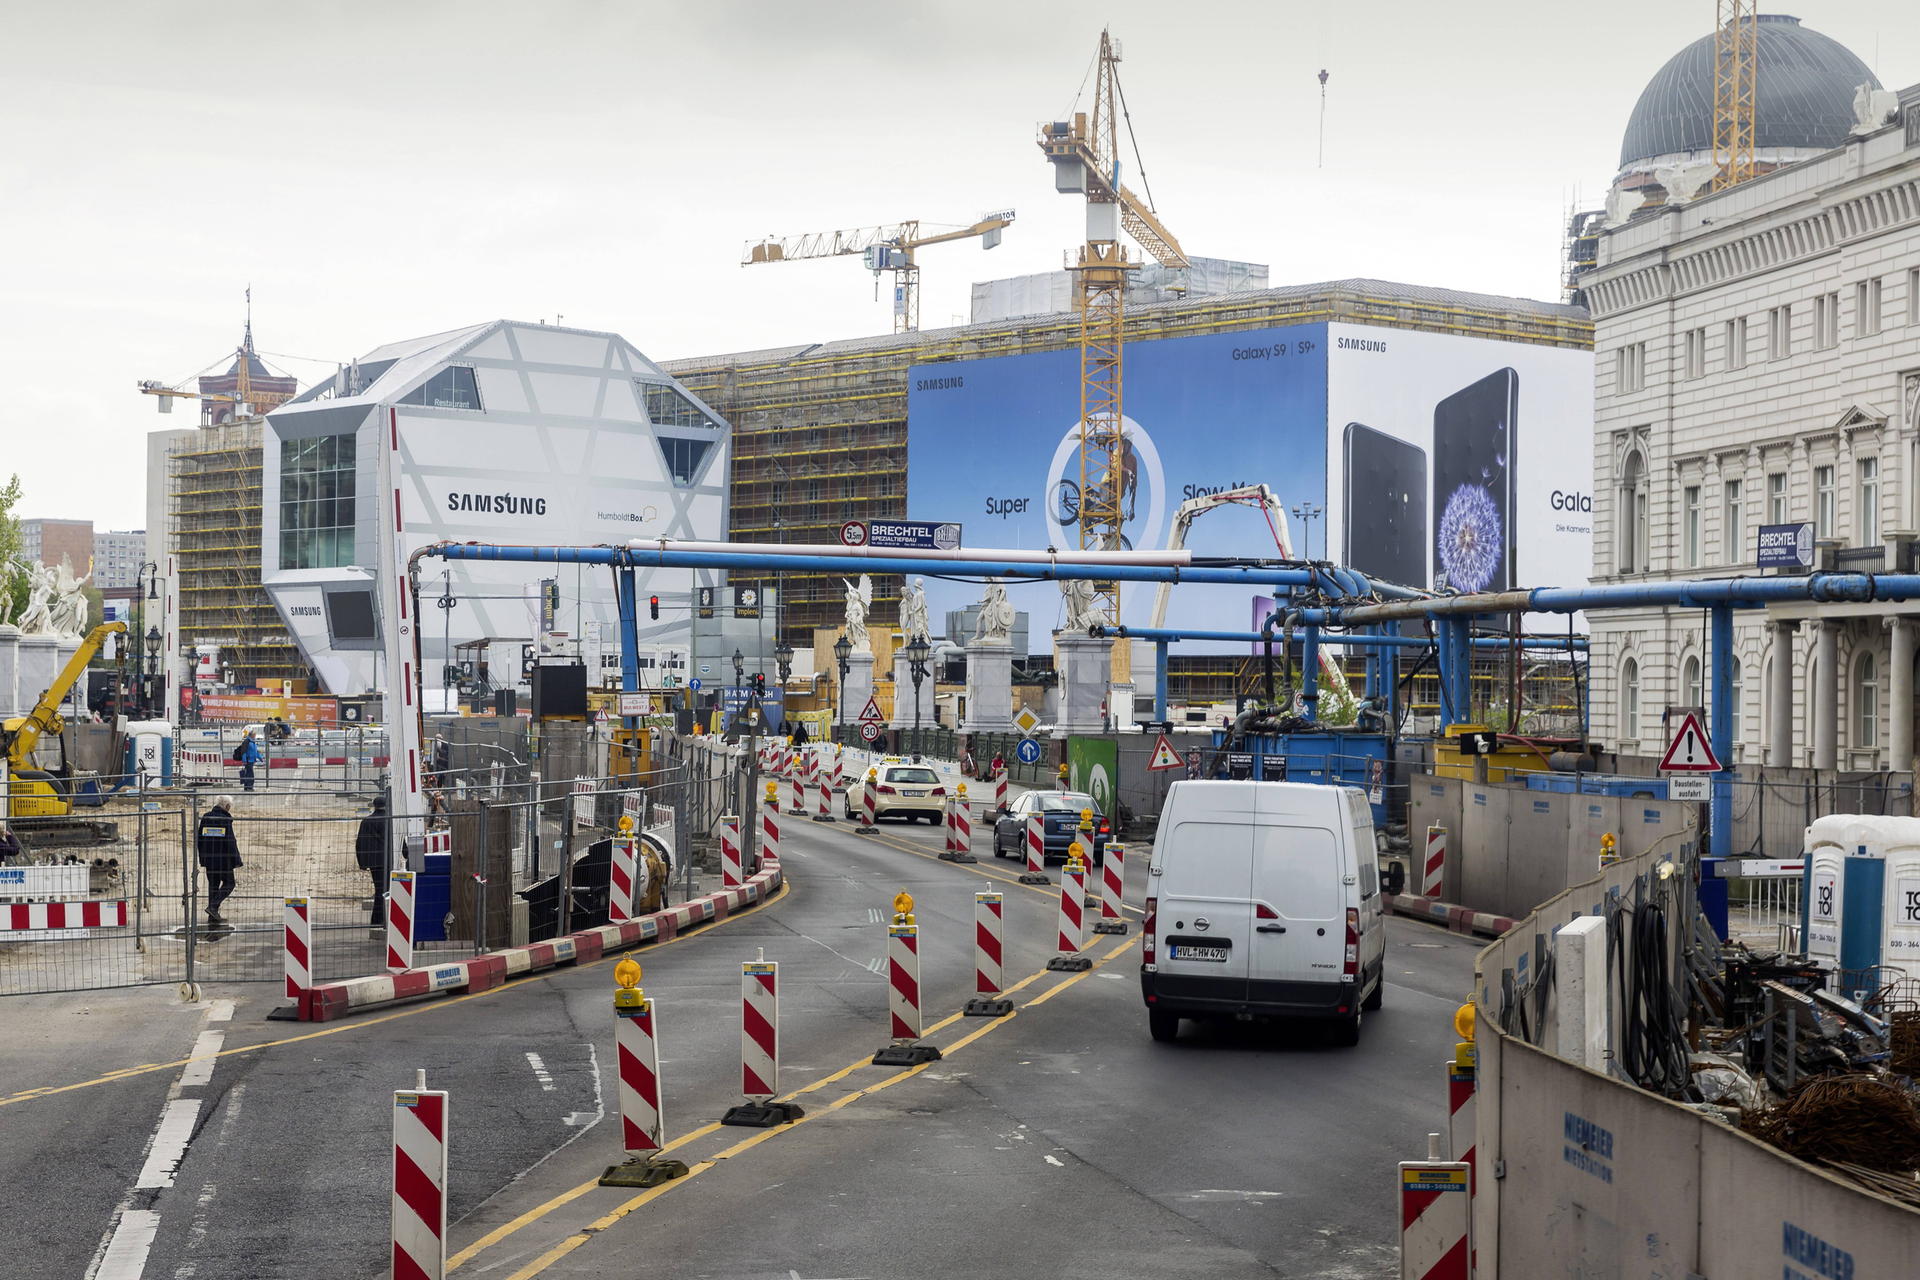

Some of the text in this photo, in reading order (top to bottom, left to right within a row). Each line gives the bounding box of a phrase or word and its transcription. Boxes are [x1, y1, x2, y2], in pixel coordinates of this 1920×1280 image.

[1338, 337, 1387, 352] SAMSUNG
[1233, 346, 1271, 360] Galaxy
[1274, 344, 1286, 356] S9
[917, 376, 964, 391] SAMSUNG
[448, 492, 546, 516] SAMSUNG
[986, 497, 1030, 520] Super
[598, 511, 643, 522] HumboldtBox
[872, 525, 932, 537] BRECHTEL
[1556, 524, 1565, 532] Die
[1760, 532, 1796, 547] BRECHTEL
[291, 606, 321, 616] SAMSUNG
[865, 727, 876, 736] 30
[1674, 780, 1705, 788] Baustellen-
[1679, 790, 1701, 798] ausfahrt
[1176, 946, 1225, 959] HVL HW 470
[1564, 1111, 1613, 1161] NIEMEIER
[1783, 1220, 1855, 1280] NIEMEIER
